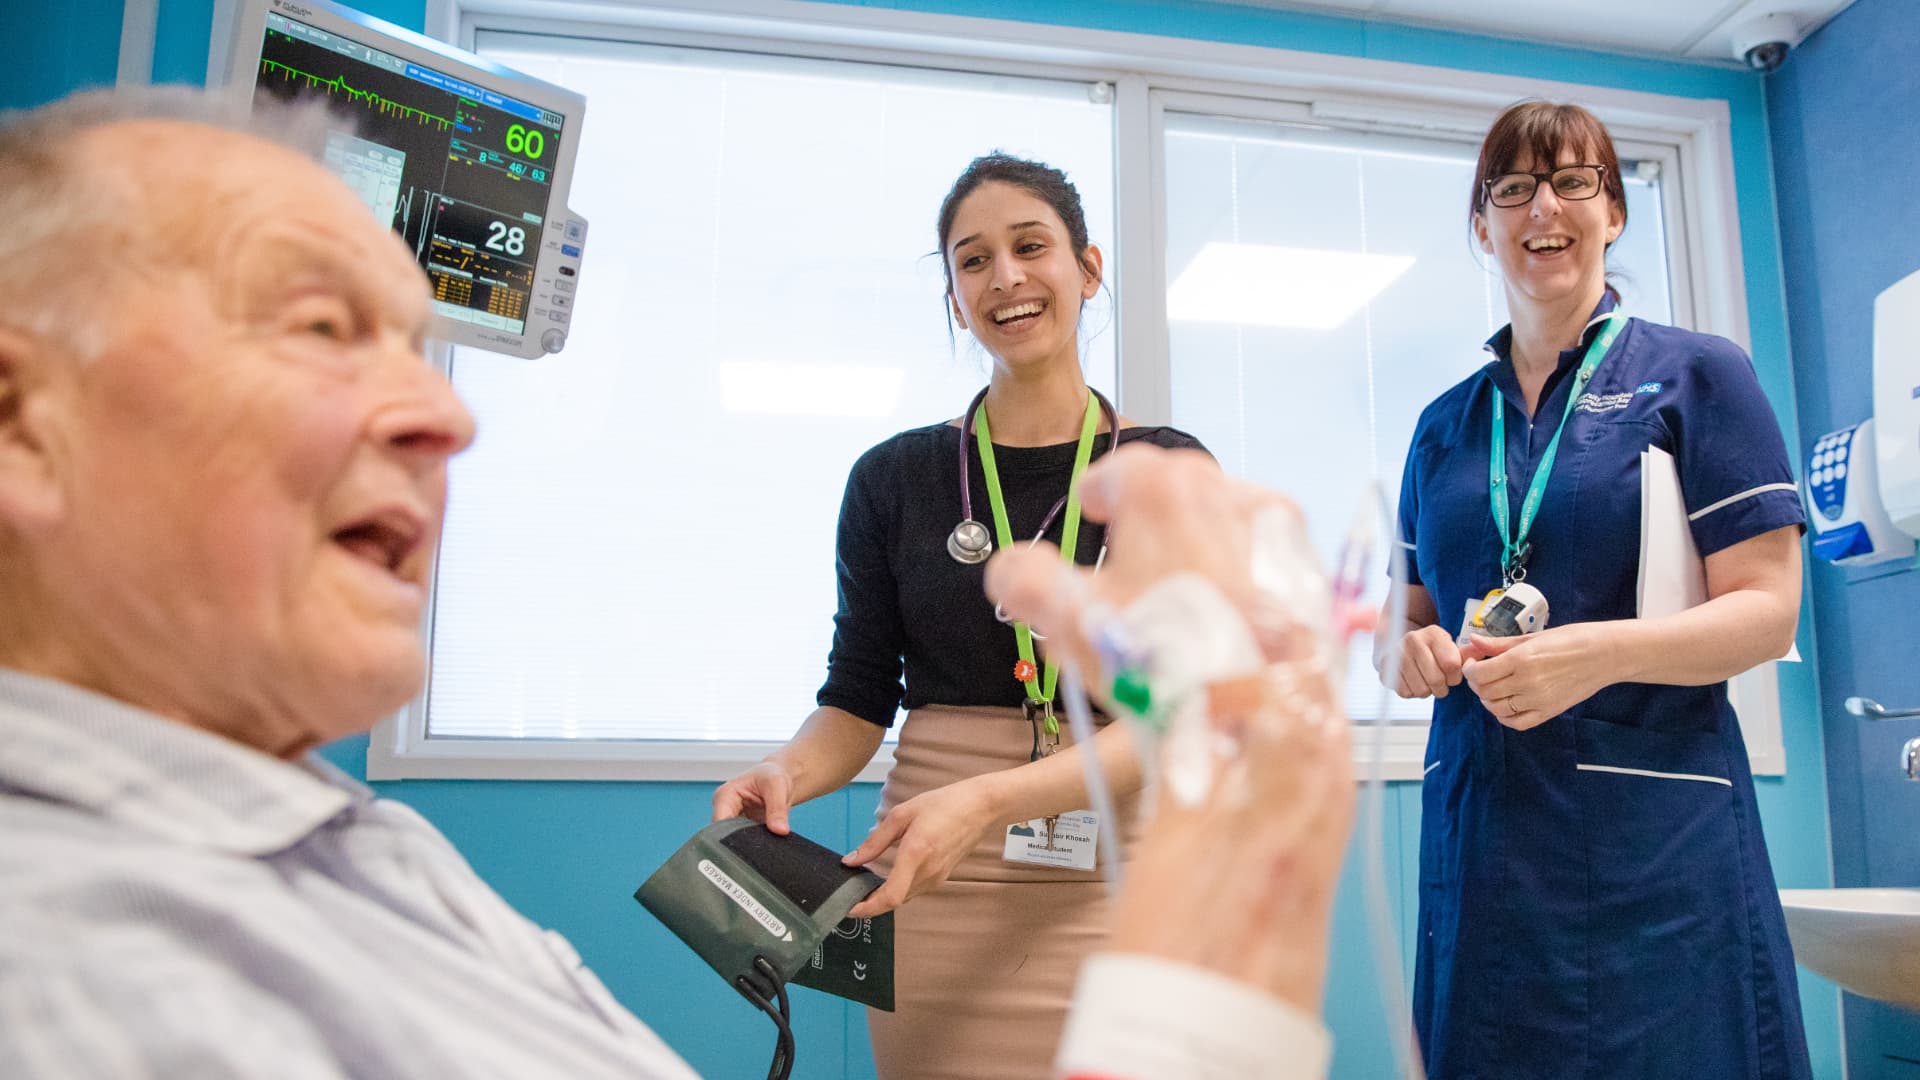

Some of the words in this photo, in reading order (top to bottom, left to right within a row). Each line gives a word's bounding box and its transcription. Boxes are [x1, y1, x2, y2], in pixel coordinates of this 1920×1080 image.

[505, 123, 545, 160] 60
[485, 220, 526, 257] 28
[1636, 382, 1660, 393] NHS
[703, 864, 733, 891] MARKER
[732, 887, 755, 909] INDEX
[753, 907, 783, 932] ARTERY
[853, 960, 867, 980] CE
